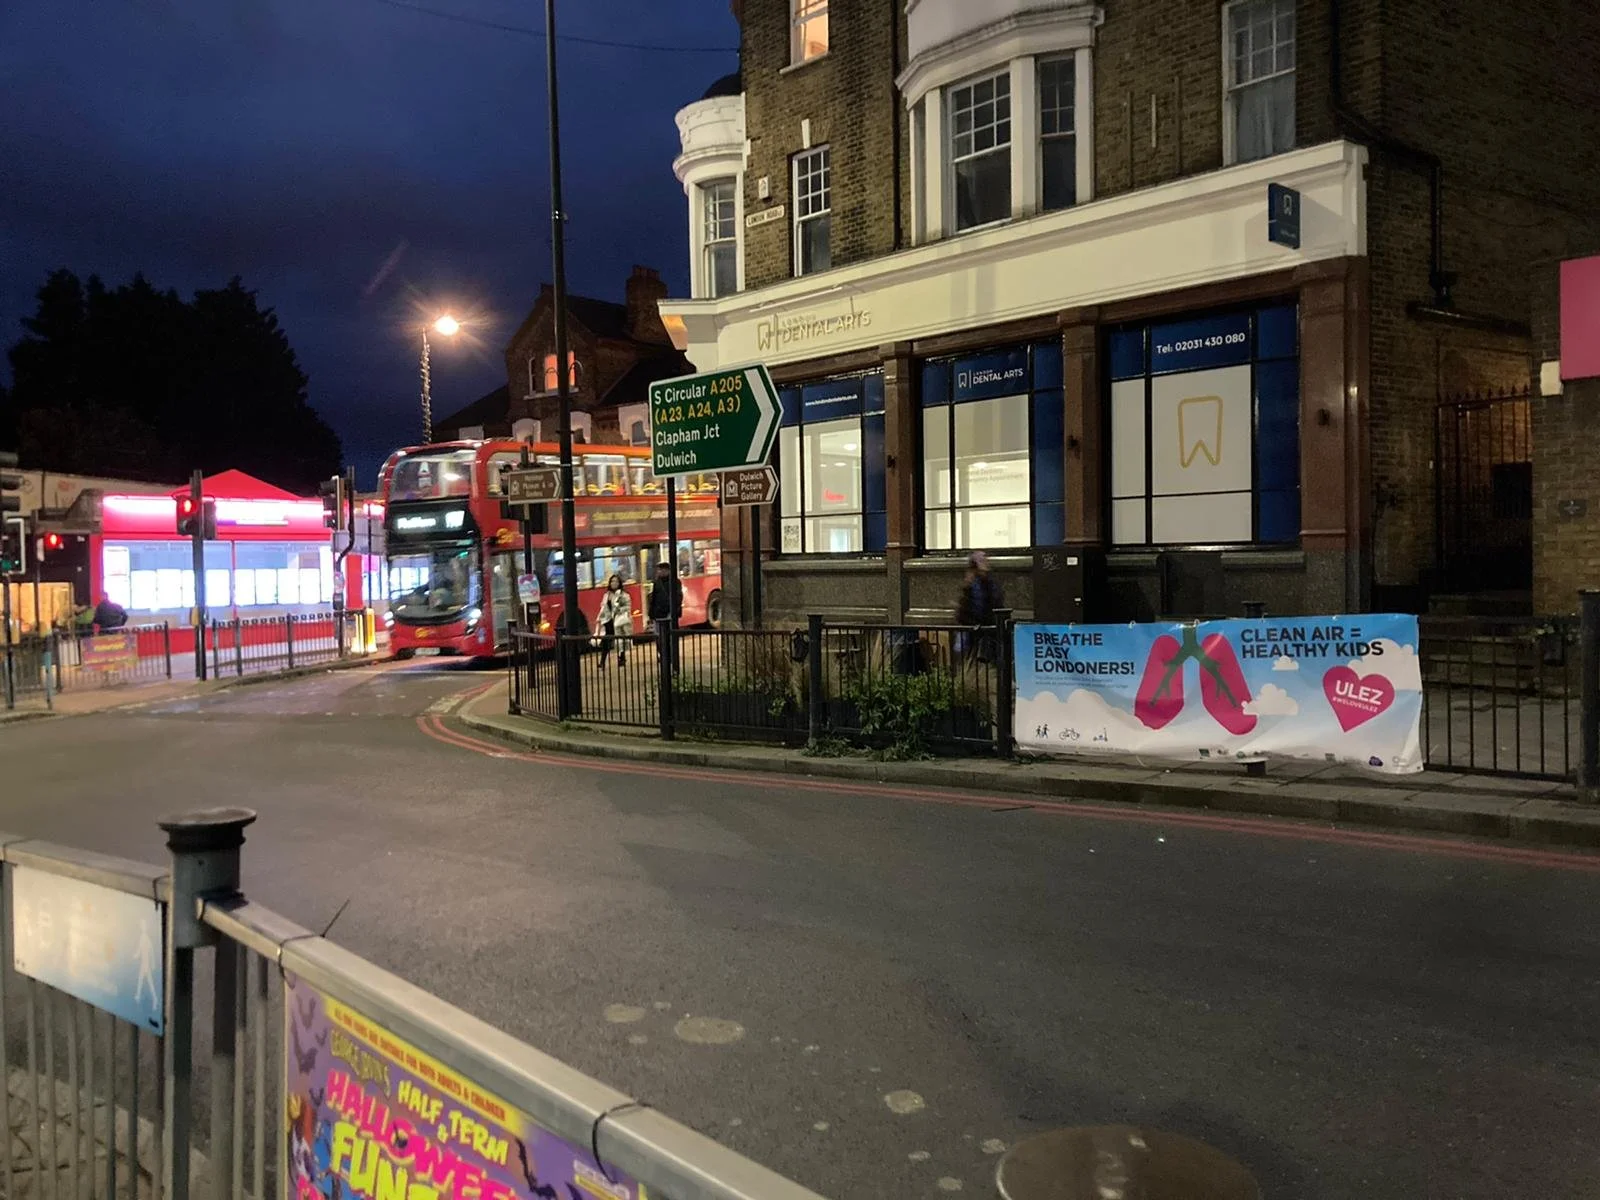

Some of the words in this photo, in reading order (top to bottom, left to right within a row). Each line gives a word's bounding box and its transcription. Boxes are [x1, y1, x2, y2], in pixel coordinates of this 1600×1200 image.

[782, 319, 834, 344] DENTAL
[836, 310, 872, 332] ARTS
[1175, 339, 1203, 351] 02031
[1204, 335, 1223, 346] 430
[1225, 332, 1245, 344] 080
[973, 372, 1002, 385] DENTAL
[1003, 368, 1024, 379] ARTS
[654, 390, 661, 405] S
[665, 384, 707, 403] Circular
[656, 428, 700, 446] Clapham
[703, 423, 720, 440] Jct
[657, 450, 697, 468] Dulwich
[740, 472, 764, 482] Dulwich
[741, 482, 762, 491] Picture
[1033, 632, 1103, 646] BREATHE
[1240, 627, 1306, 643] CLEAN
[1312, 626, 1345, 641] AIR
[1034, 646, 1070, 660] EASY
[1242, 642, 1330, 659] HEALTHY
[1336, 641, 1384, 657] KIDS
[1034, 660, 1135, 675] LONDONERS!
[1335, 679, 1384, 706] ULEZ
[398, 1080, 443, 1125] HALF
[448, 1110, 509, 1166] TERM
[437, 1123, 449, 1144] &
[330, 1121, 439, 1200] FUN
